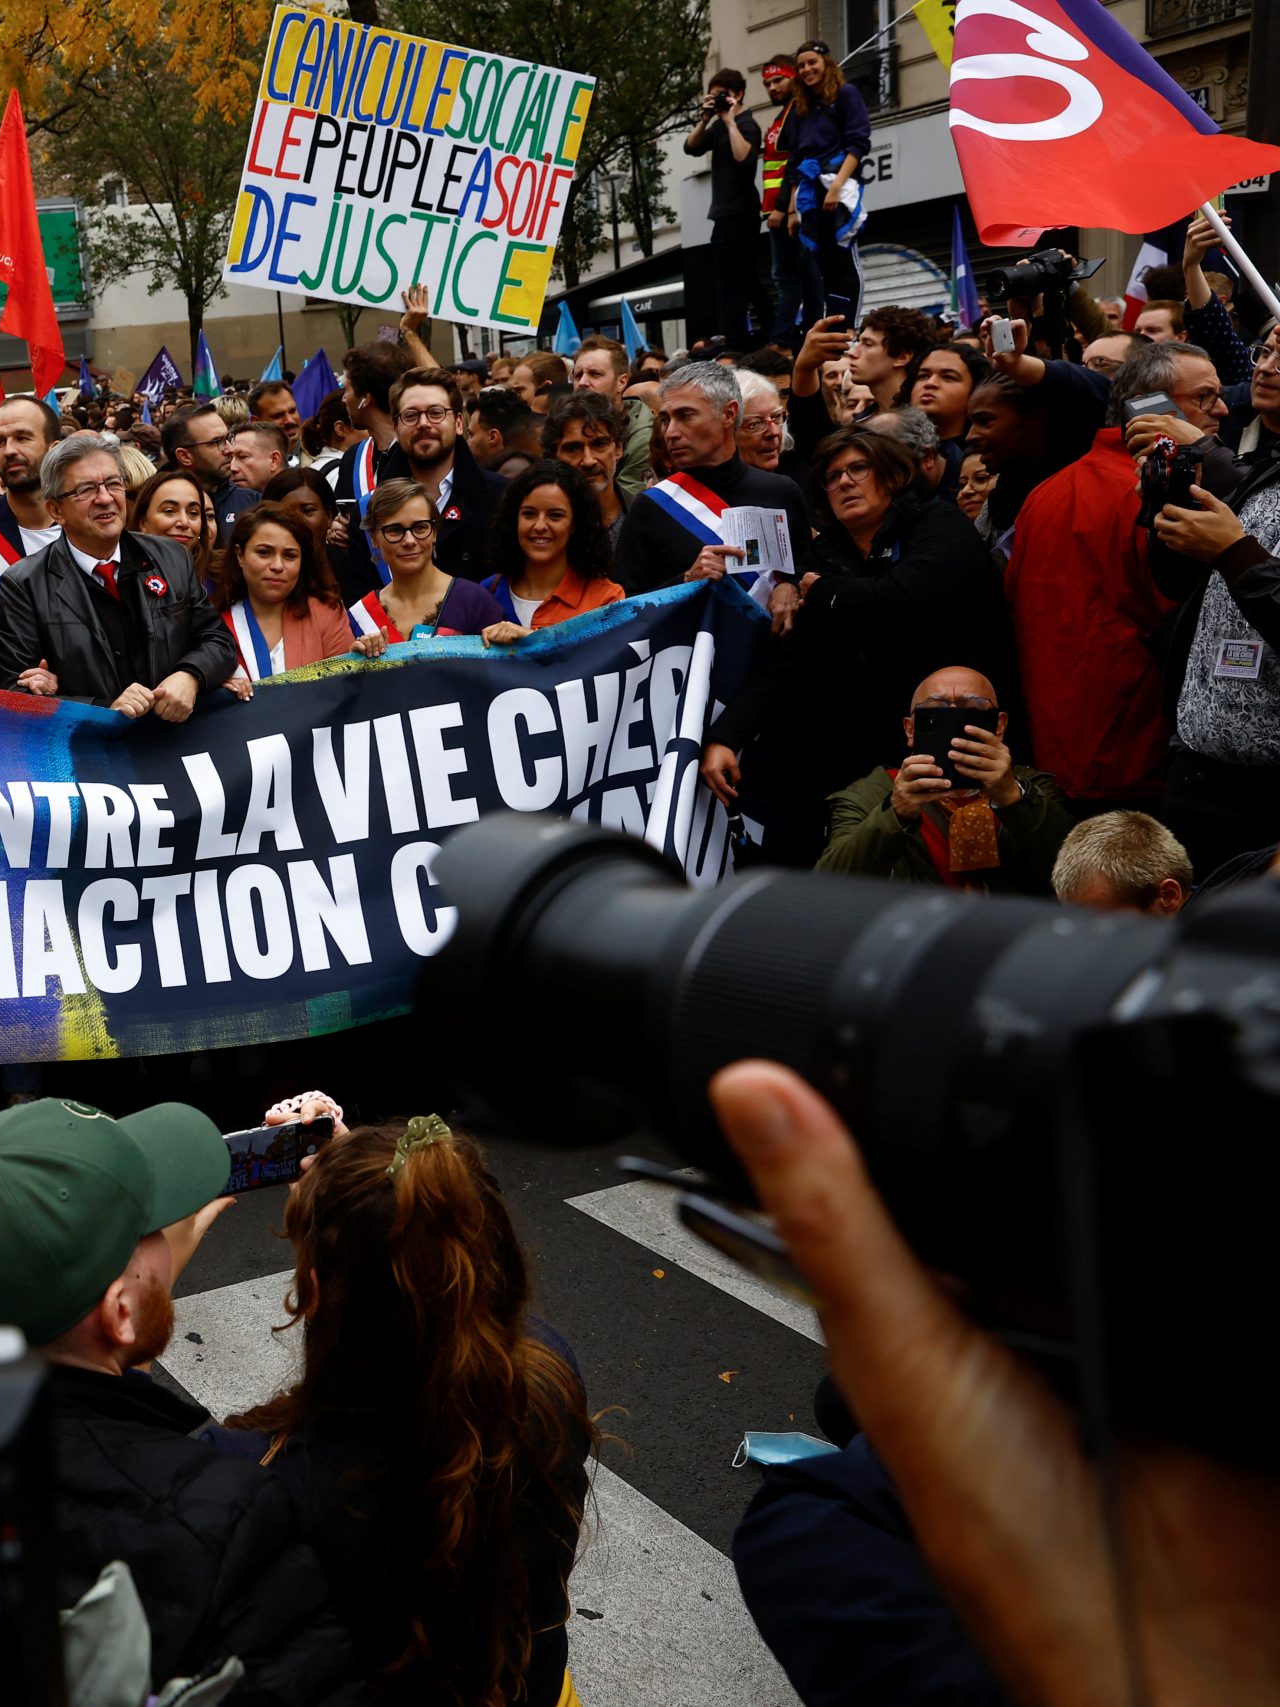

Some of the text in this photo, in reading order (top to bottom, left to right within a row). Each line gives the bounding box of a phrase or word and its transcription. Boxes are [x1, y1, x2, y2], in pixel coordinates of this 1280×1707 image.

[247, 100, 317, 181] LE
[303, 113, 478, 216] PEUPLE
[229, 184, 318, 285] DE
[634, 299, 652, 312] CAFÉ
[181, 733, 304, 860] LA
[312, 702, 480, 844] VIE
